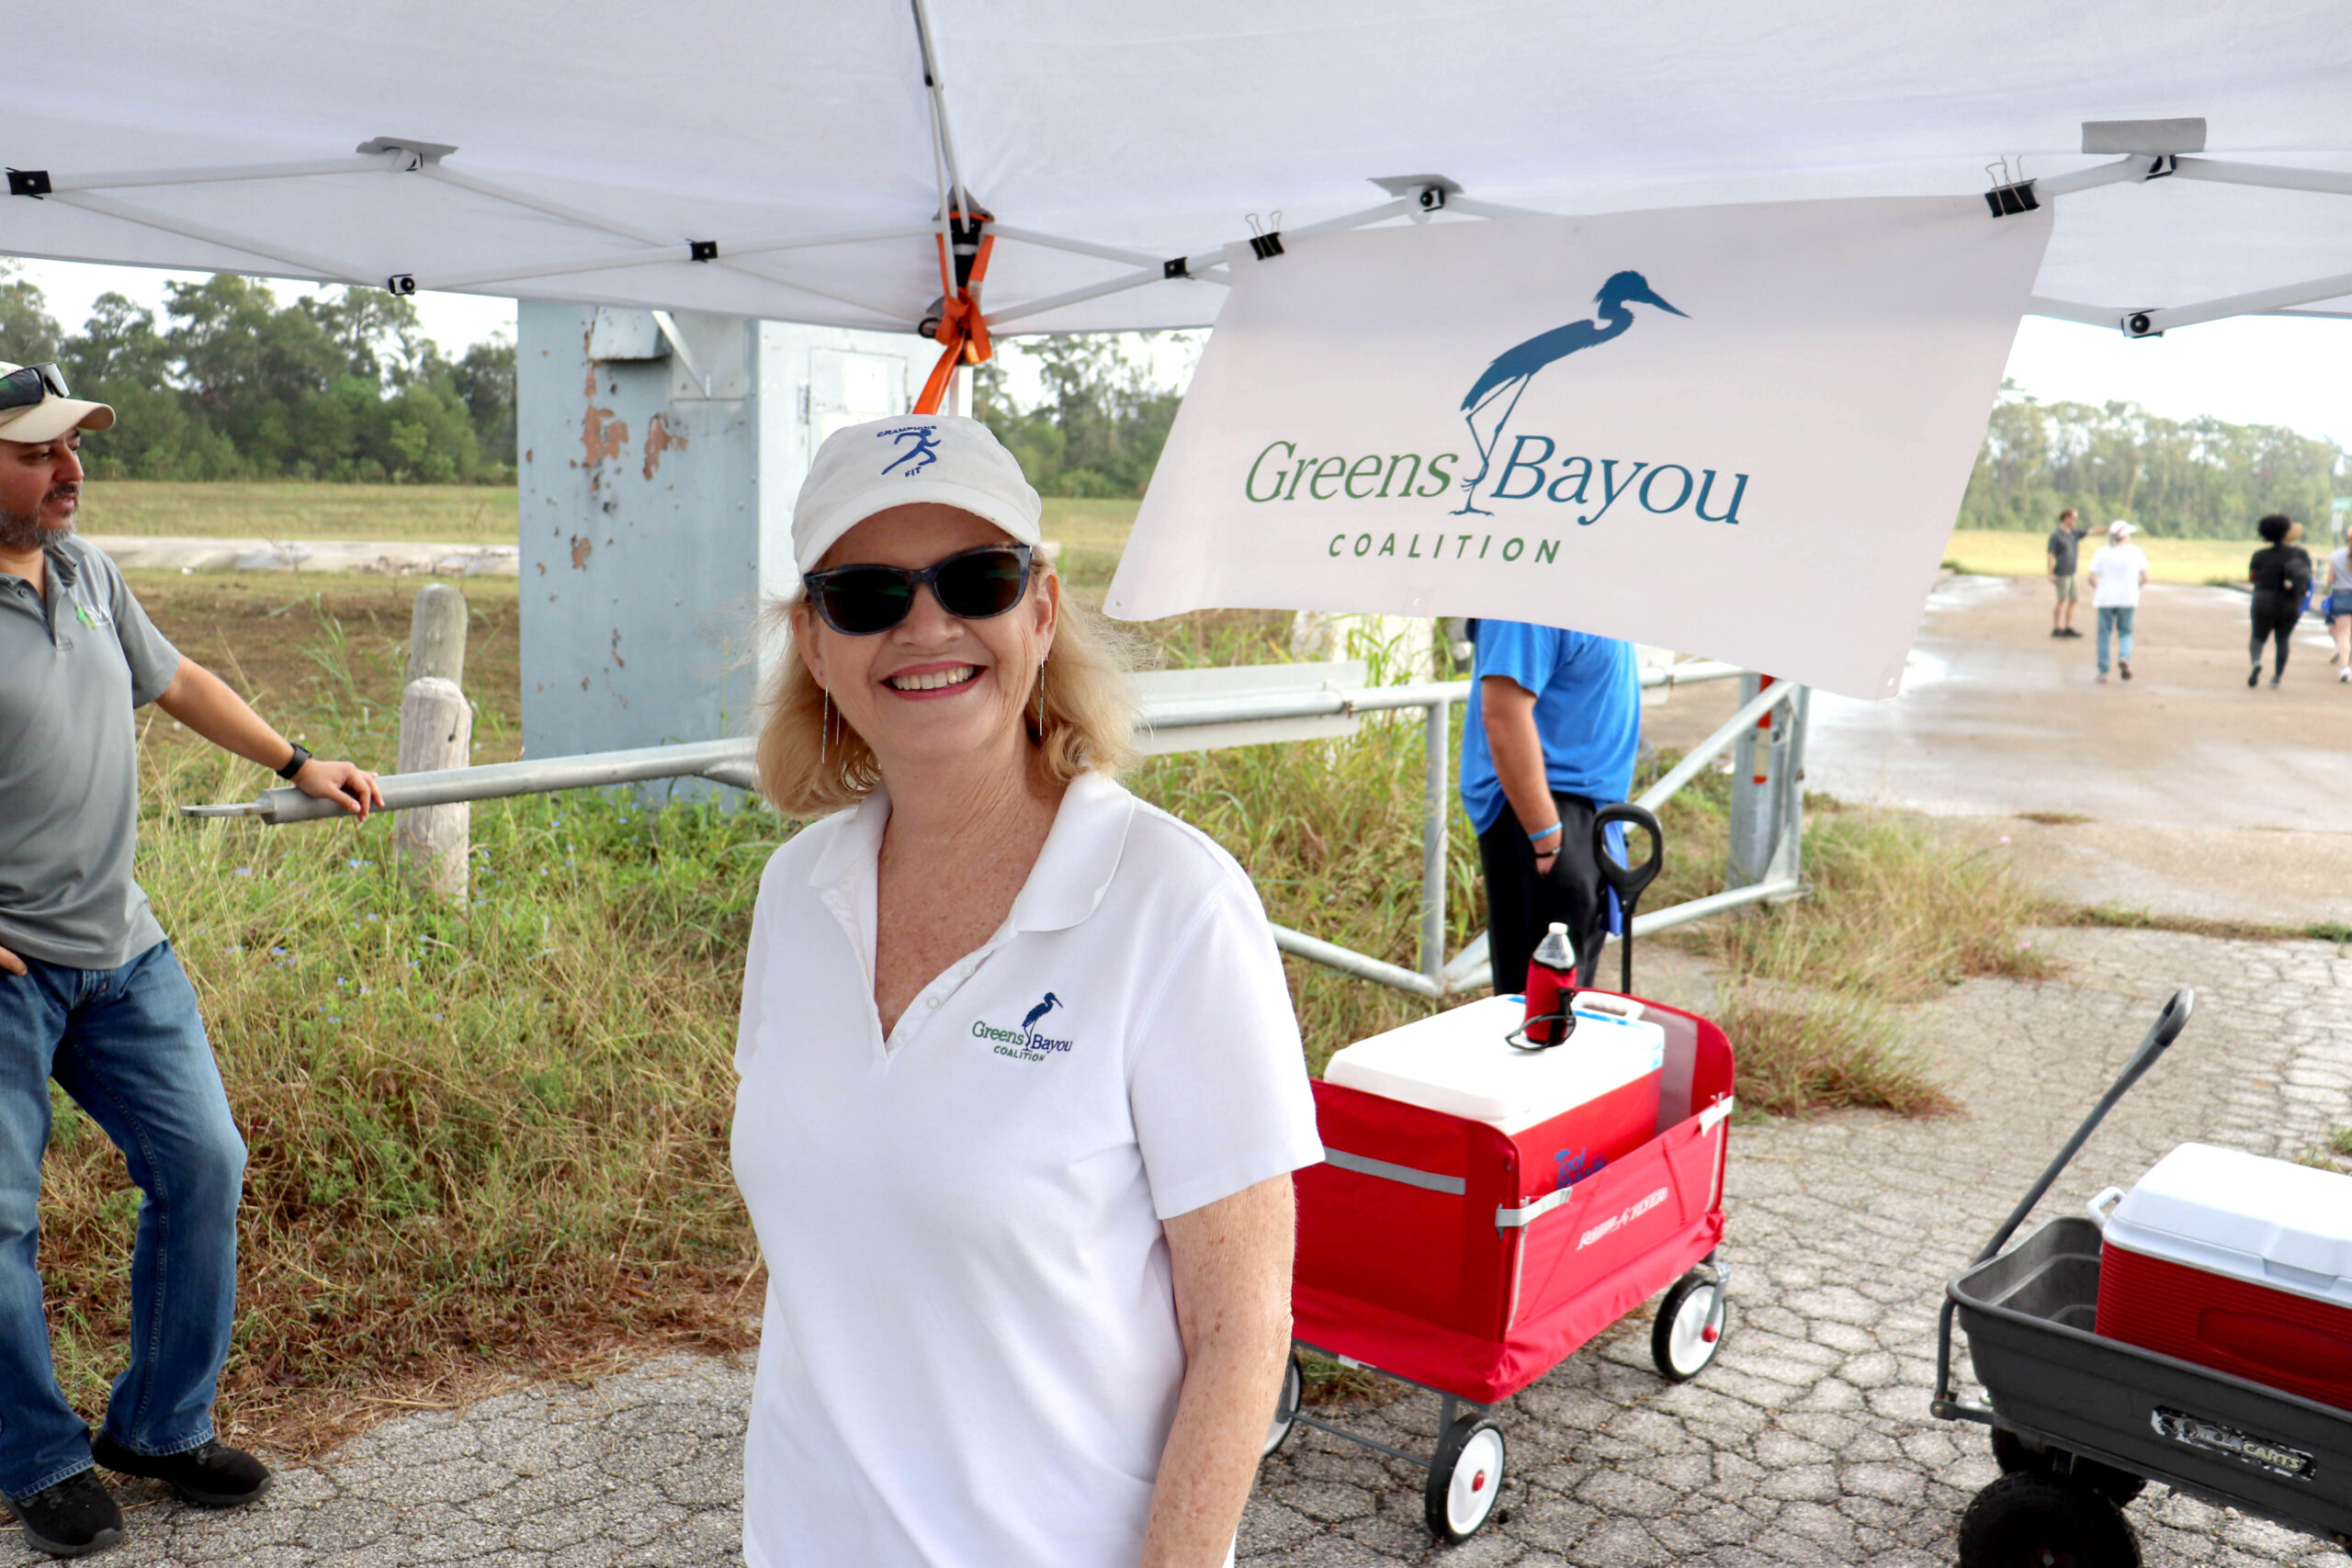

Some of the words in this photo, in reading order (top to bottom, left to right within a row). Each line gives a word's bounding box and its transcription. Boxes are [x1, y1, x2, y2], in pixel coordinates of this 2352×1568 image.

[905, 467, 922, 477] FIT
[1246, 440, 1459, 504] Greens
[1489, 434, 1750, 526] Bayou
[1328, 533, 1561, 564] COALITION
[972, 1021, 1024, 1044] Greens
[1031, 1034, 1073, 1054] Bayou
[993, 1044, 1046, 1062] COALITION
[2242, 1443, 2302, 1472] CARTS
